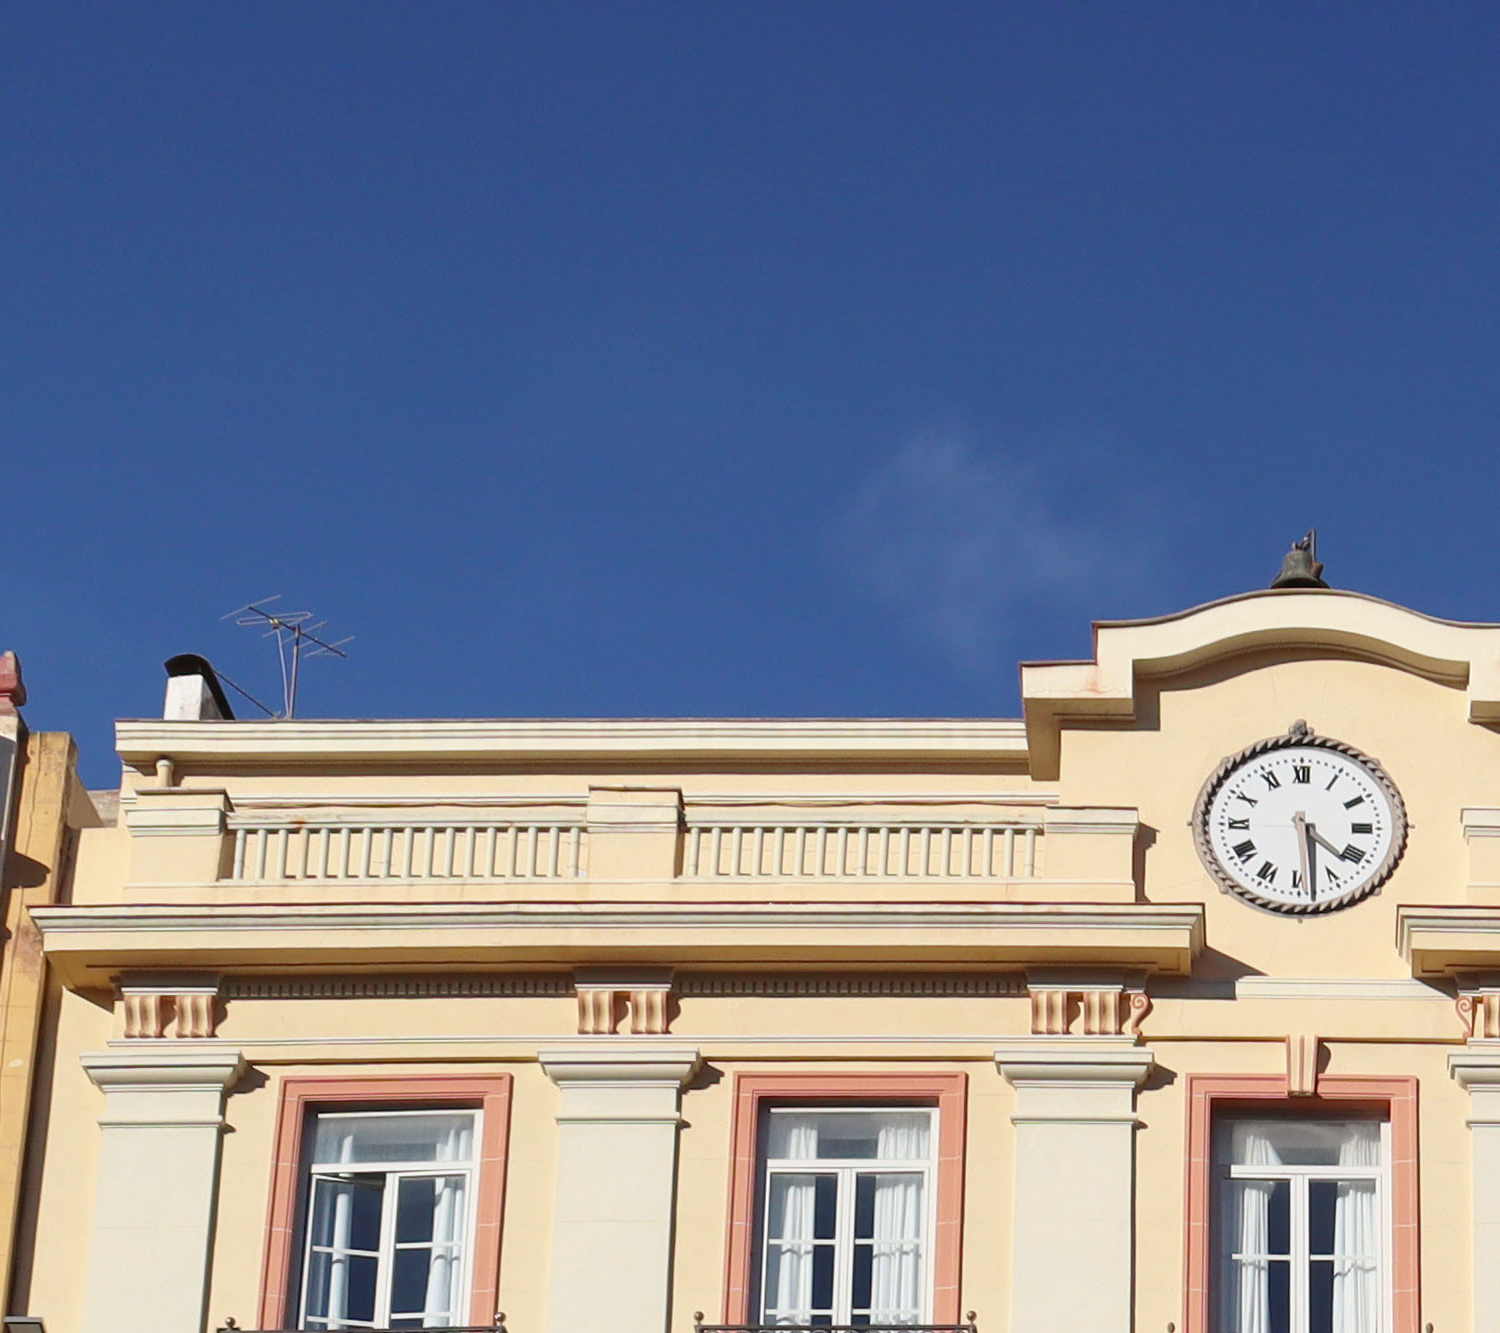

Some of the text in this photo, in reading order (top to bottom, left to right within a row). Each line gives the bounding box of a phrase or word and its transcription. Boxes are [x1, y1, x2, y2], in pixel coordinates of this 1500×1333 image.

[1260, 770, 1282, 791] XI
[1292, 765, 1311, 784] XII
[1236, 792, 1258, 808] X
